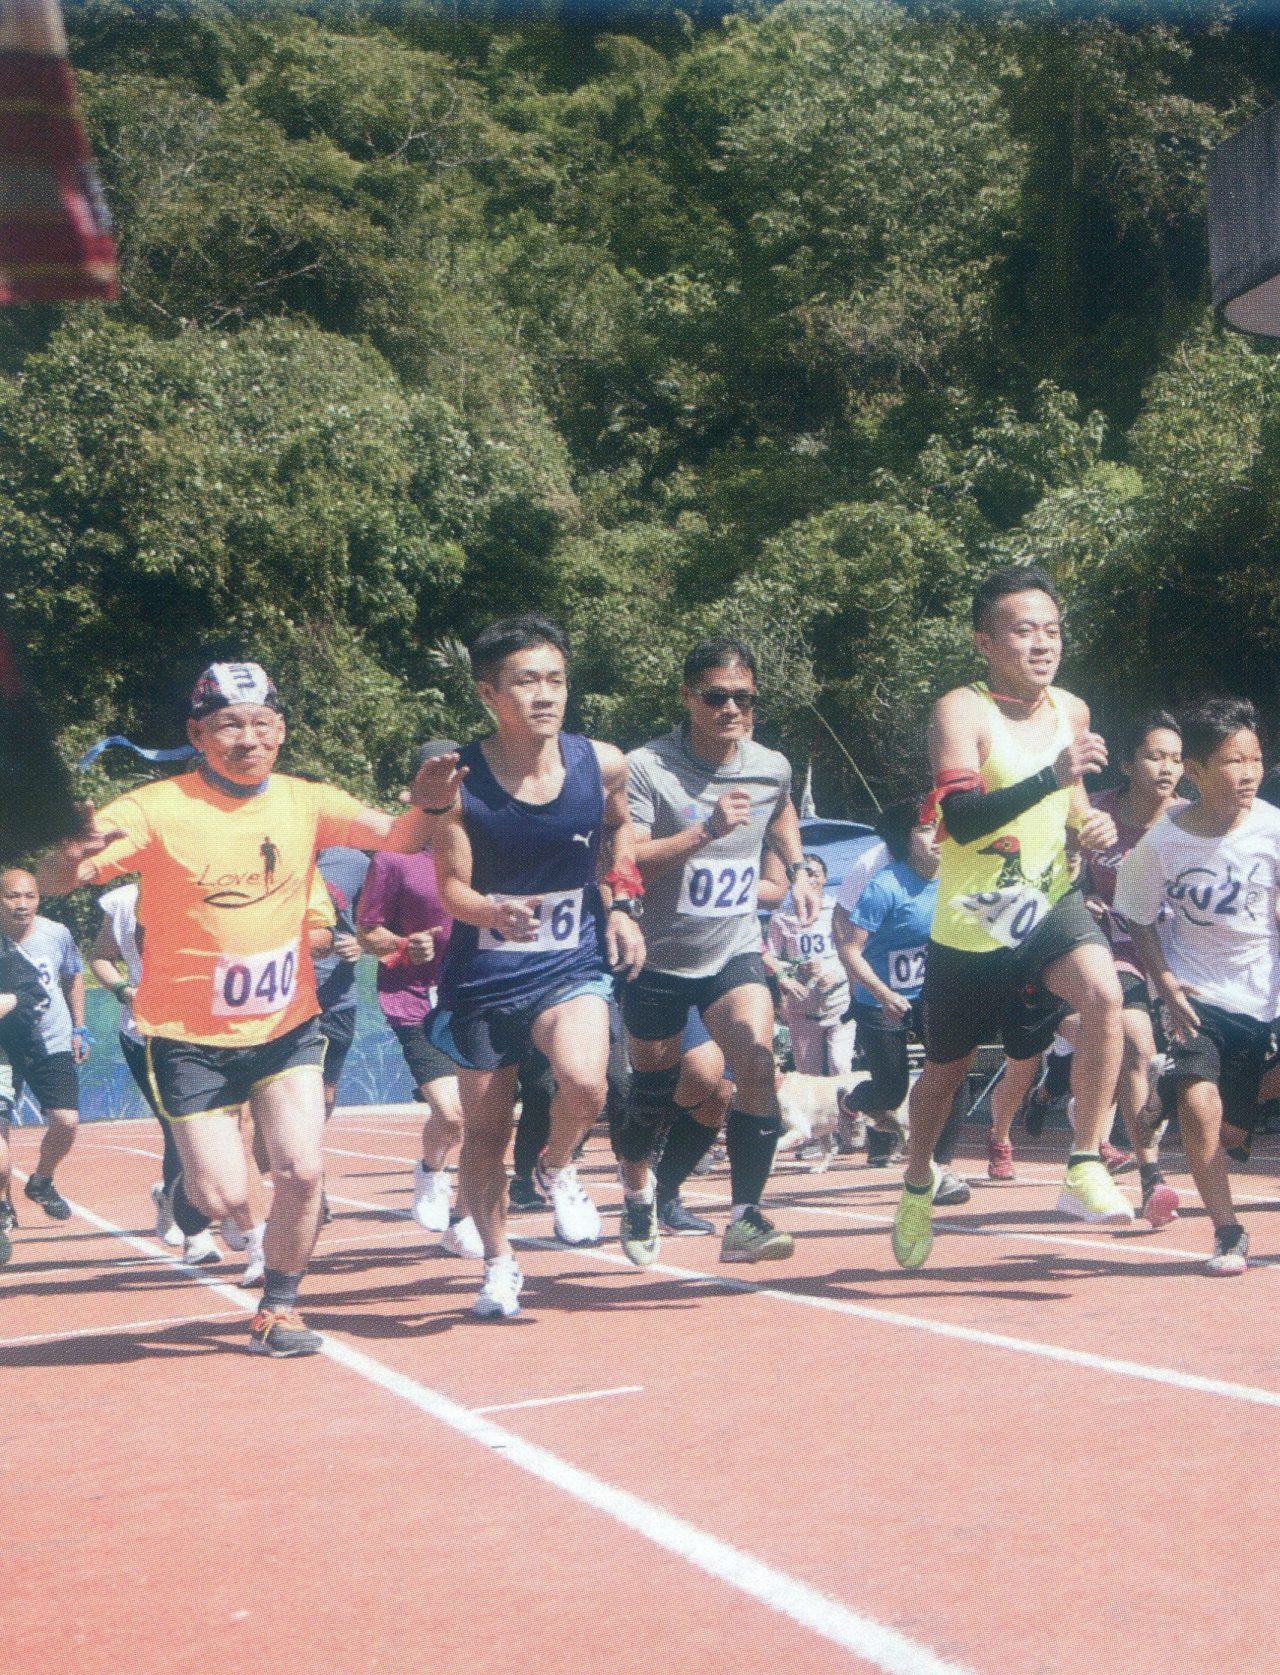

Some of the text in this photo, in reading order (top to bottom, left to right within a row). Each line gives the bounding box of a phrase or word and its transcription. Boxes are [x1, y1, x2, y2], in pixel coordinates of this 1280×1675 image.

[198, 864, 260, 887] Love
[689, 866, 755, 908] 022
[800, 933, 834, 954] 03
[224, 951, 294, 1008] 040
